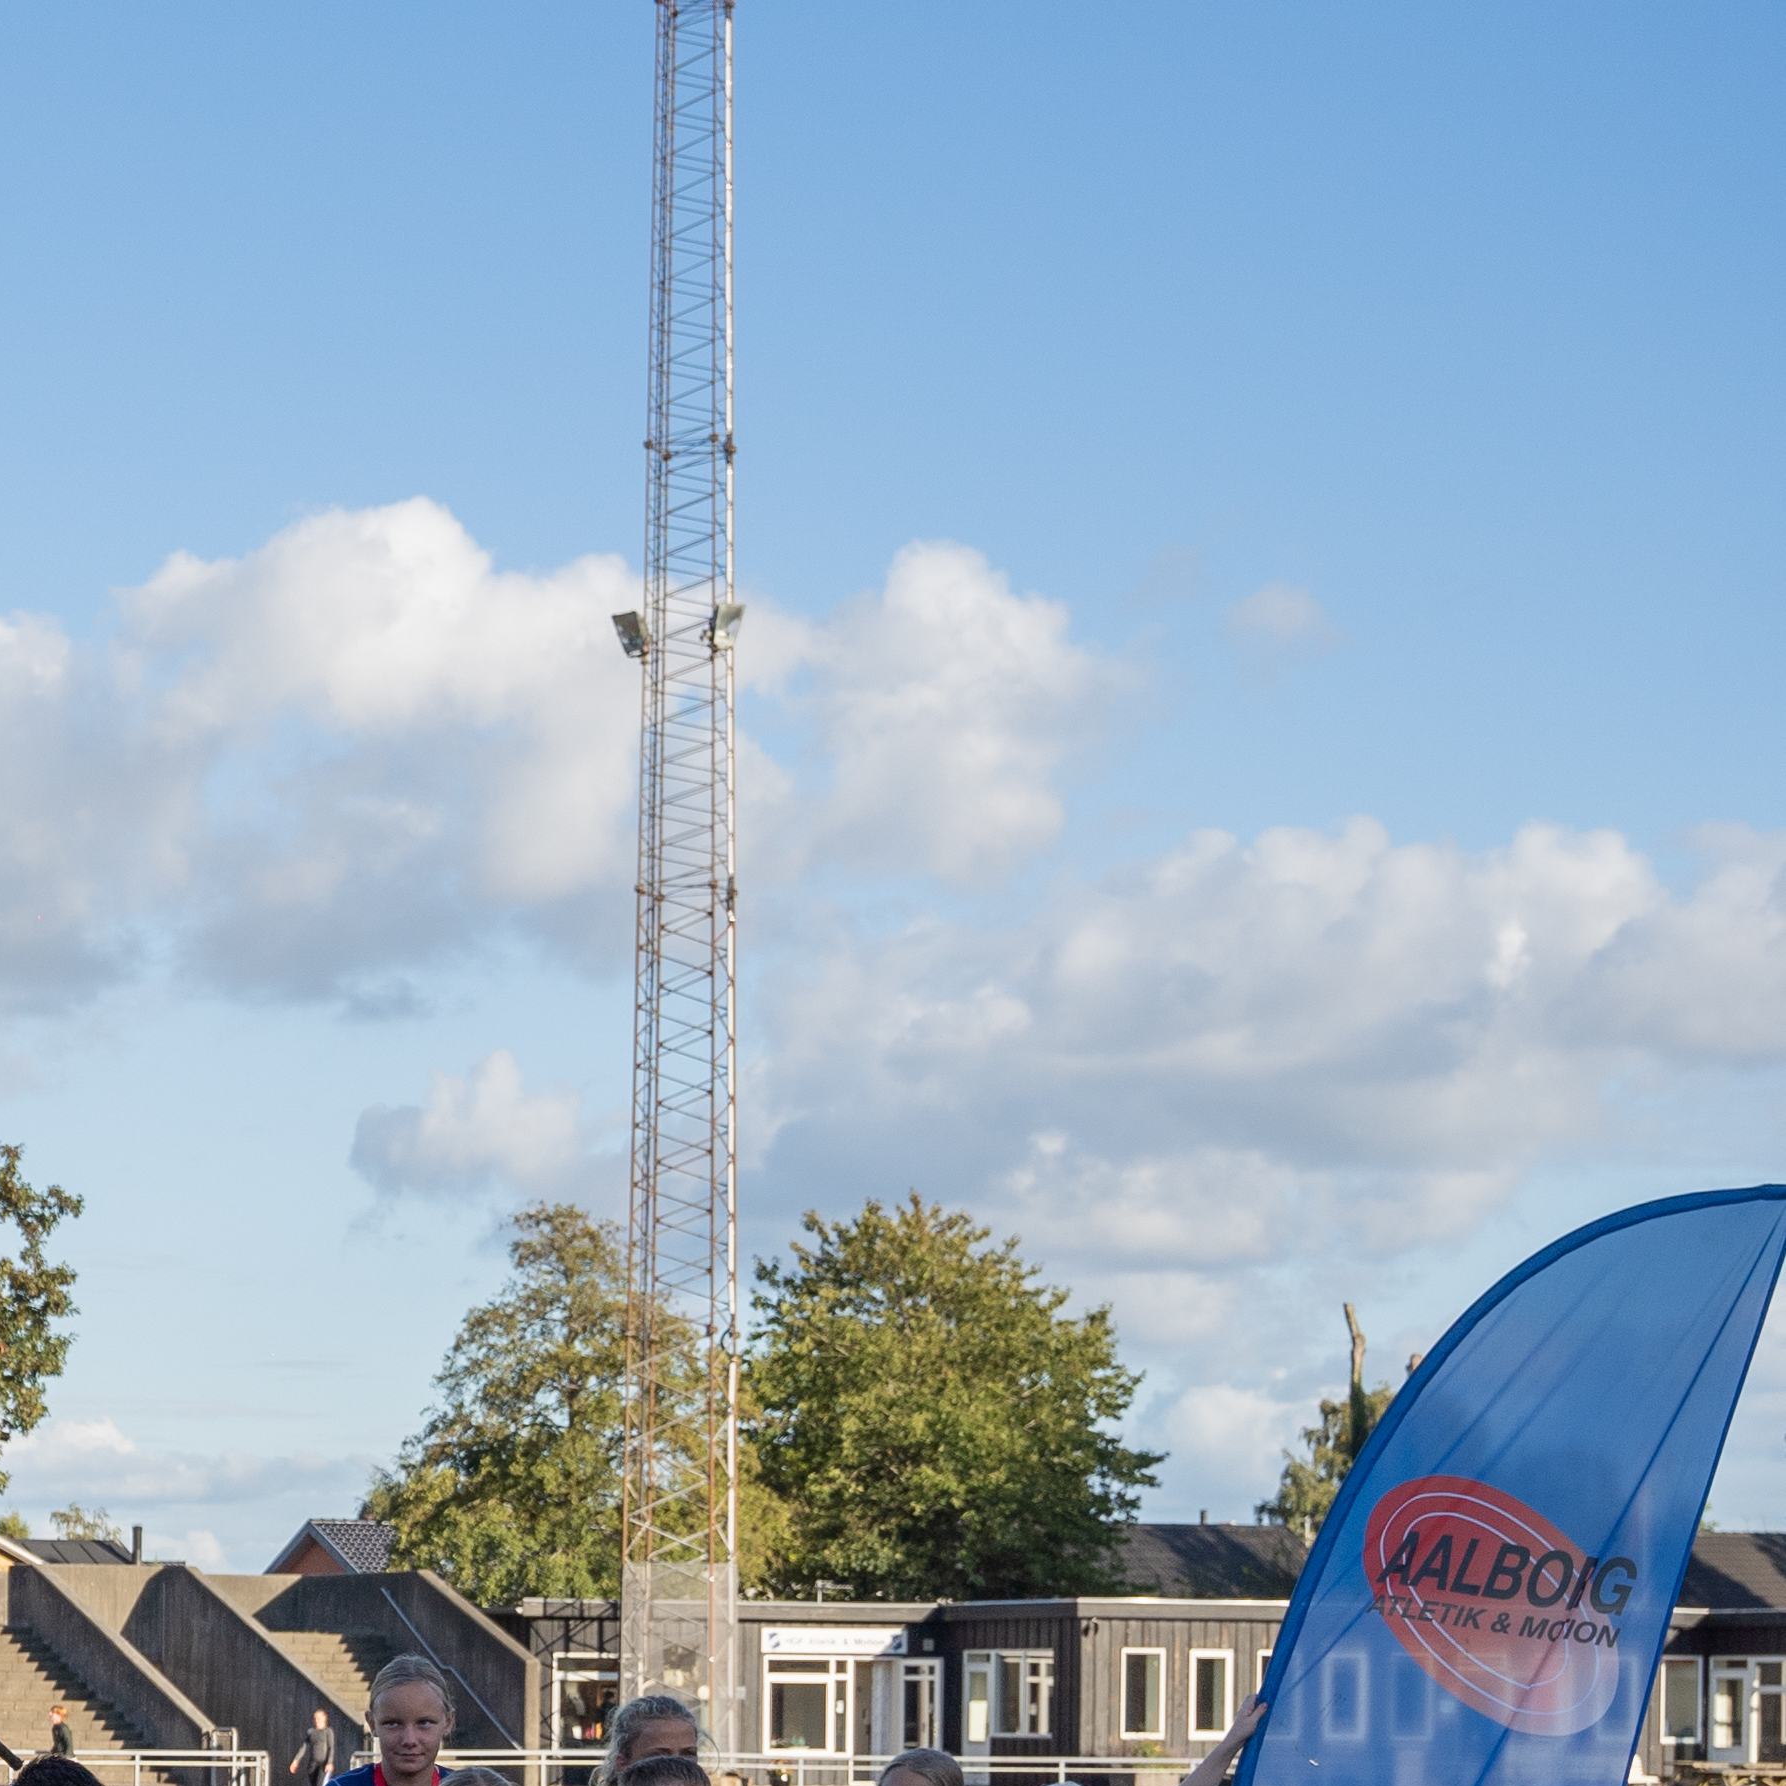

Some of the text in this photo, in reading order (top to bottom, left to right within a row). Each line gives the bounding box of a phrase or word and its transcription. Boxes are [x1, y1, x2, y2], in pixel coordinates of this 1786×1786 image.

[1366, 1592, 1622, 1649] ATLETIK & MOION
